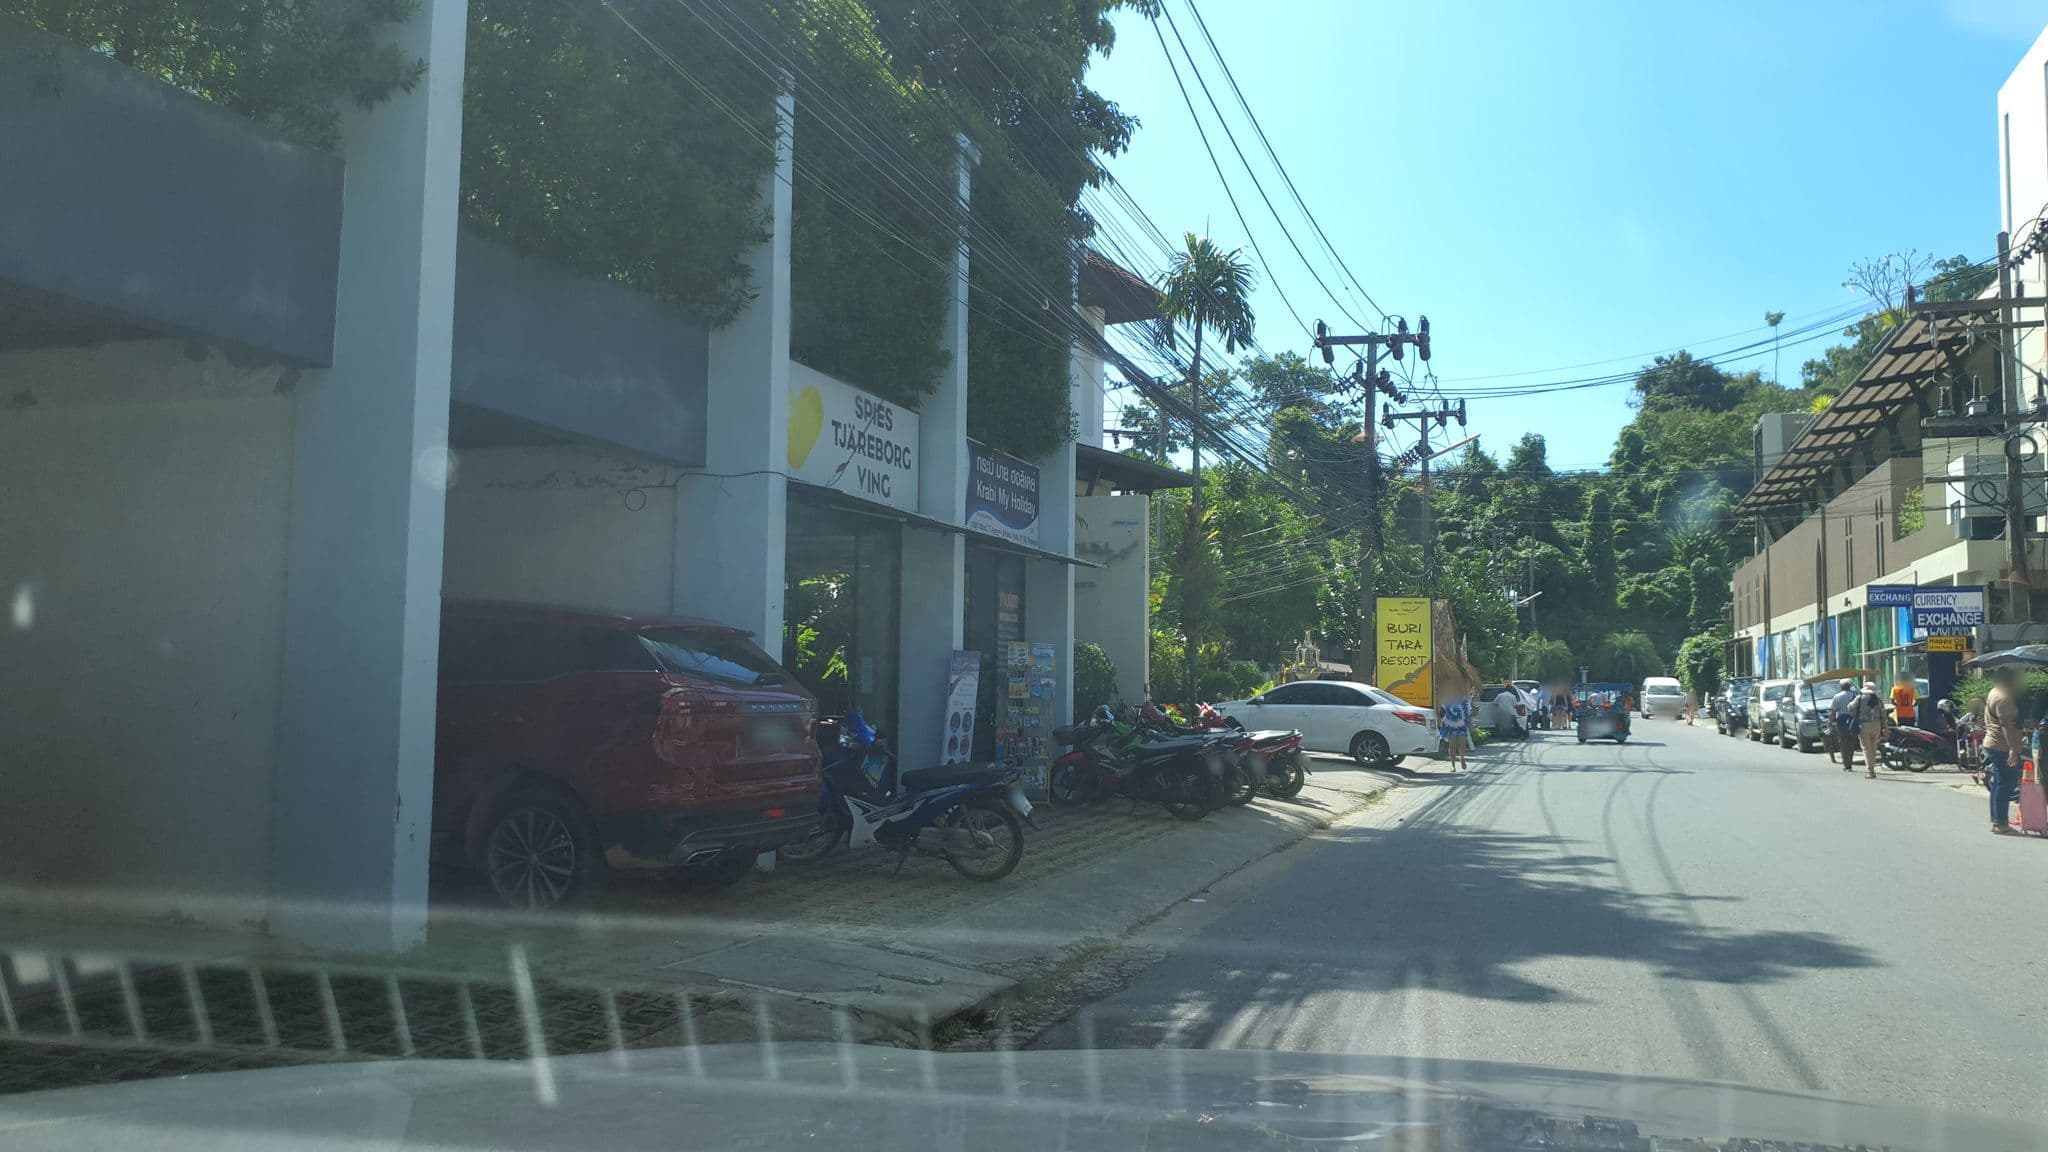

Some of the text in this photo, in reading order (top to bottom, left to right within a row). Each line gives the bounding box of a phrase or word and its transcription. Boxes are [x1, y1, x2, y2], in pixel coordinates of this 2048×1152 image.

[855, 395, 893, 432] SPIES
[831, 419, 912, 470] TJÄREBORG
[857, 465, 891, 498] VING
[976, 479, 1036, 520] Krabi My Holiday
[1915, 594, 1957, 606] CURRENCY
[1917, 612, 1982, 626] EXCHANGE
[1386, 623, 1422, 634] BURI
[1384, 639, 1423, 651] TARA
[1380, 655, 1427, 666] RESORT
